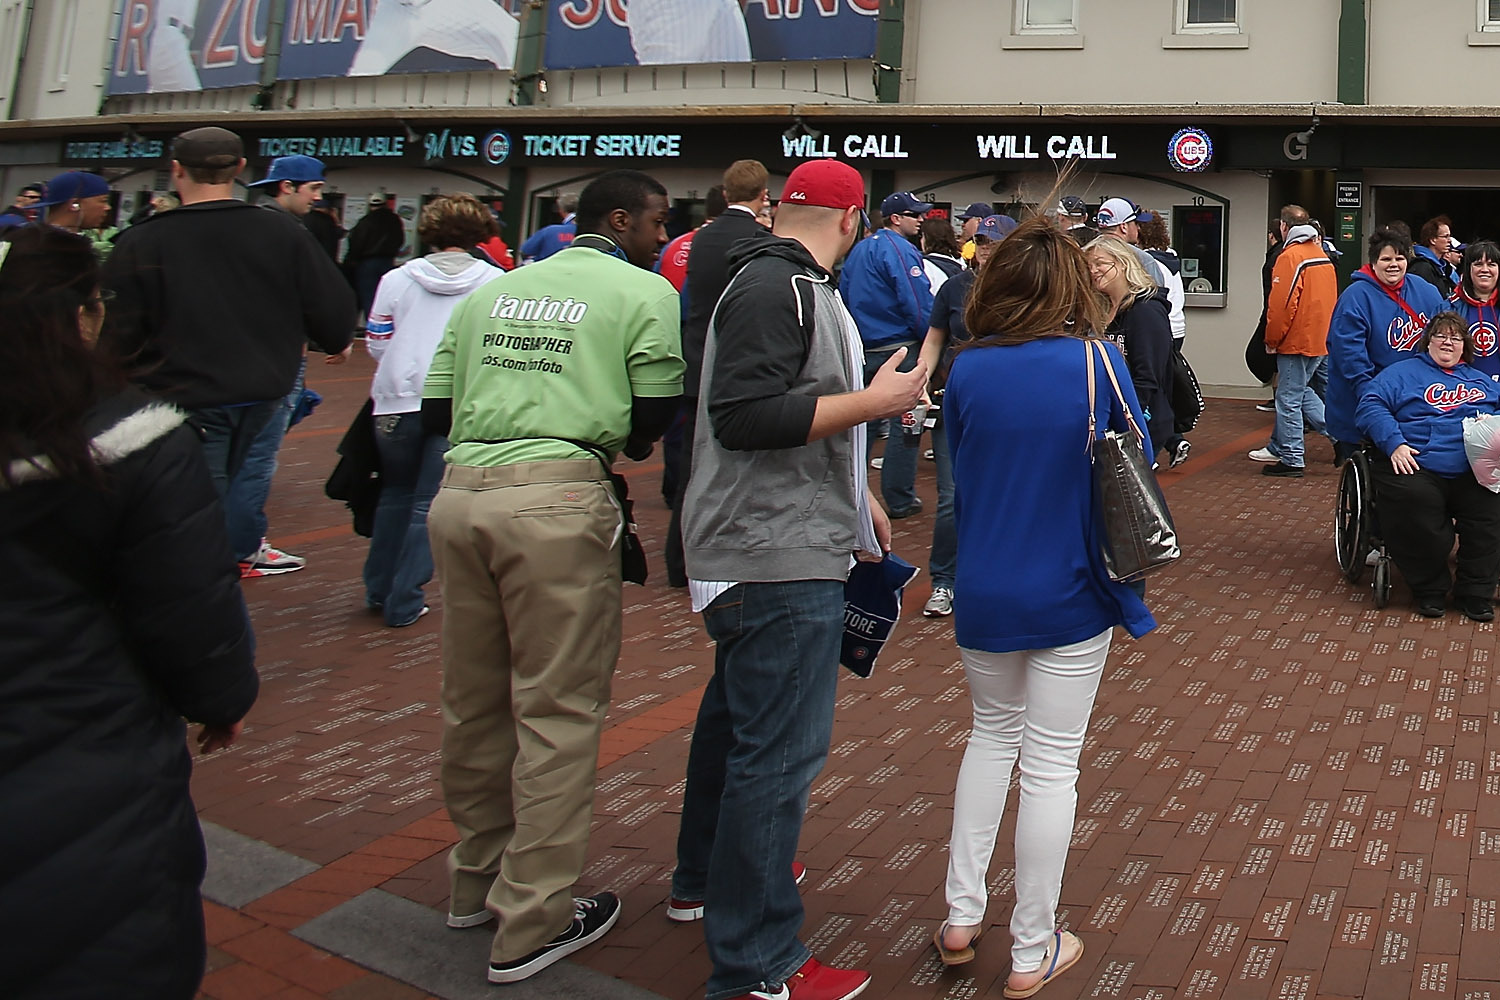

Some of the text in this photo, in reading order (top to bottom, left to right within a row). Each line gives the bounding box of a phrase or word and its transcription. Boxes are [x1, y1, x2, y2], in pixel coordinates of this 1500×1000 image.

[259, 136, 405, 157] TICKETS AVAILABLE
[452, 136, 479, 157] VS.
[523, 135, 681, 156] TICKET SERVICE
[782, 134, 909, 158] WILL CALL
[977, 135, 1117, 159] WILL CALL
[1283, 132, 1307, 161] G
[923, 192, 936, 202] 13
[1192, 196, 1204, 207] 10
[489, 293, 588, 324] fanfoto
[1423, 383, 1487, 410] Cubs
[843, 609, 878, 635] TORE
